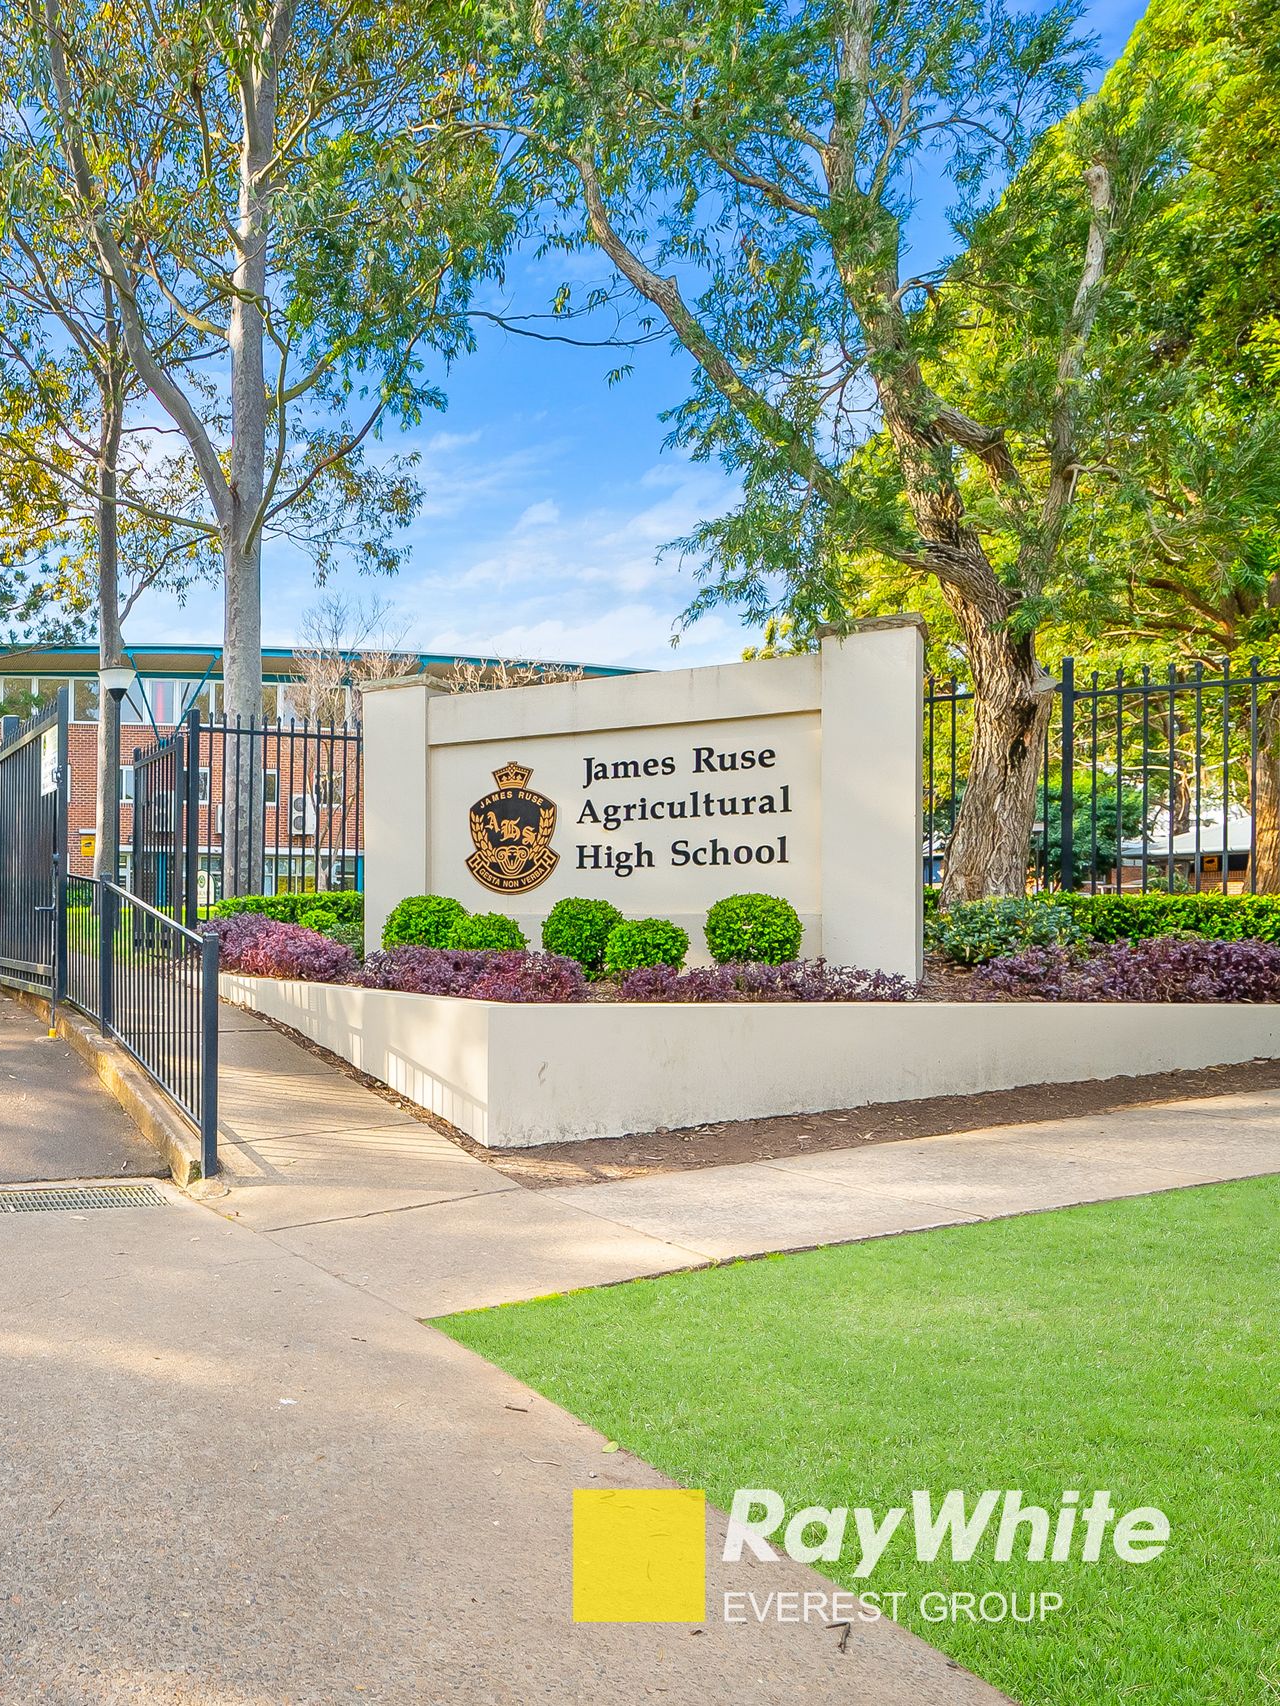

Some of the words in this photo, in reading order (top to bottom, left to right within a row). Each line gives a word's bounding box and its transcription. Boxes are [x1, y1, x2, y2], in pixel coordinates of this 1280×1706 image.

[583, 757, 676, 789] James
[693, 747, 776, 773] Ruse
[479, 790, 513, 808] JAMES
[518, 791, 544, 806] RUSE
[576, 785, 792, 830] Agricultural
[576, 842, 655, 877] High
[671, 836, 789, 866] School
[479, 868, 500, 886] GESTA
[502, 880, 519, 888] NON
[520, 867, 545, 886] VERBA
